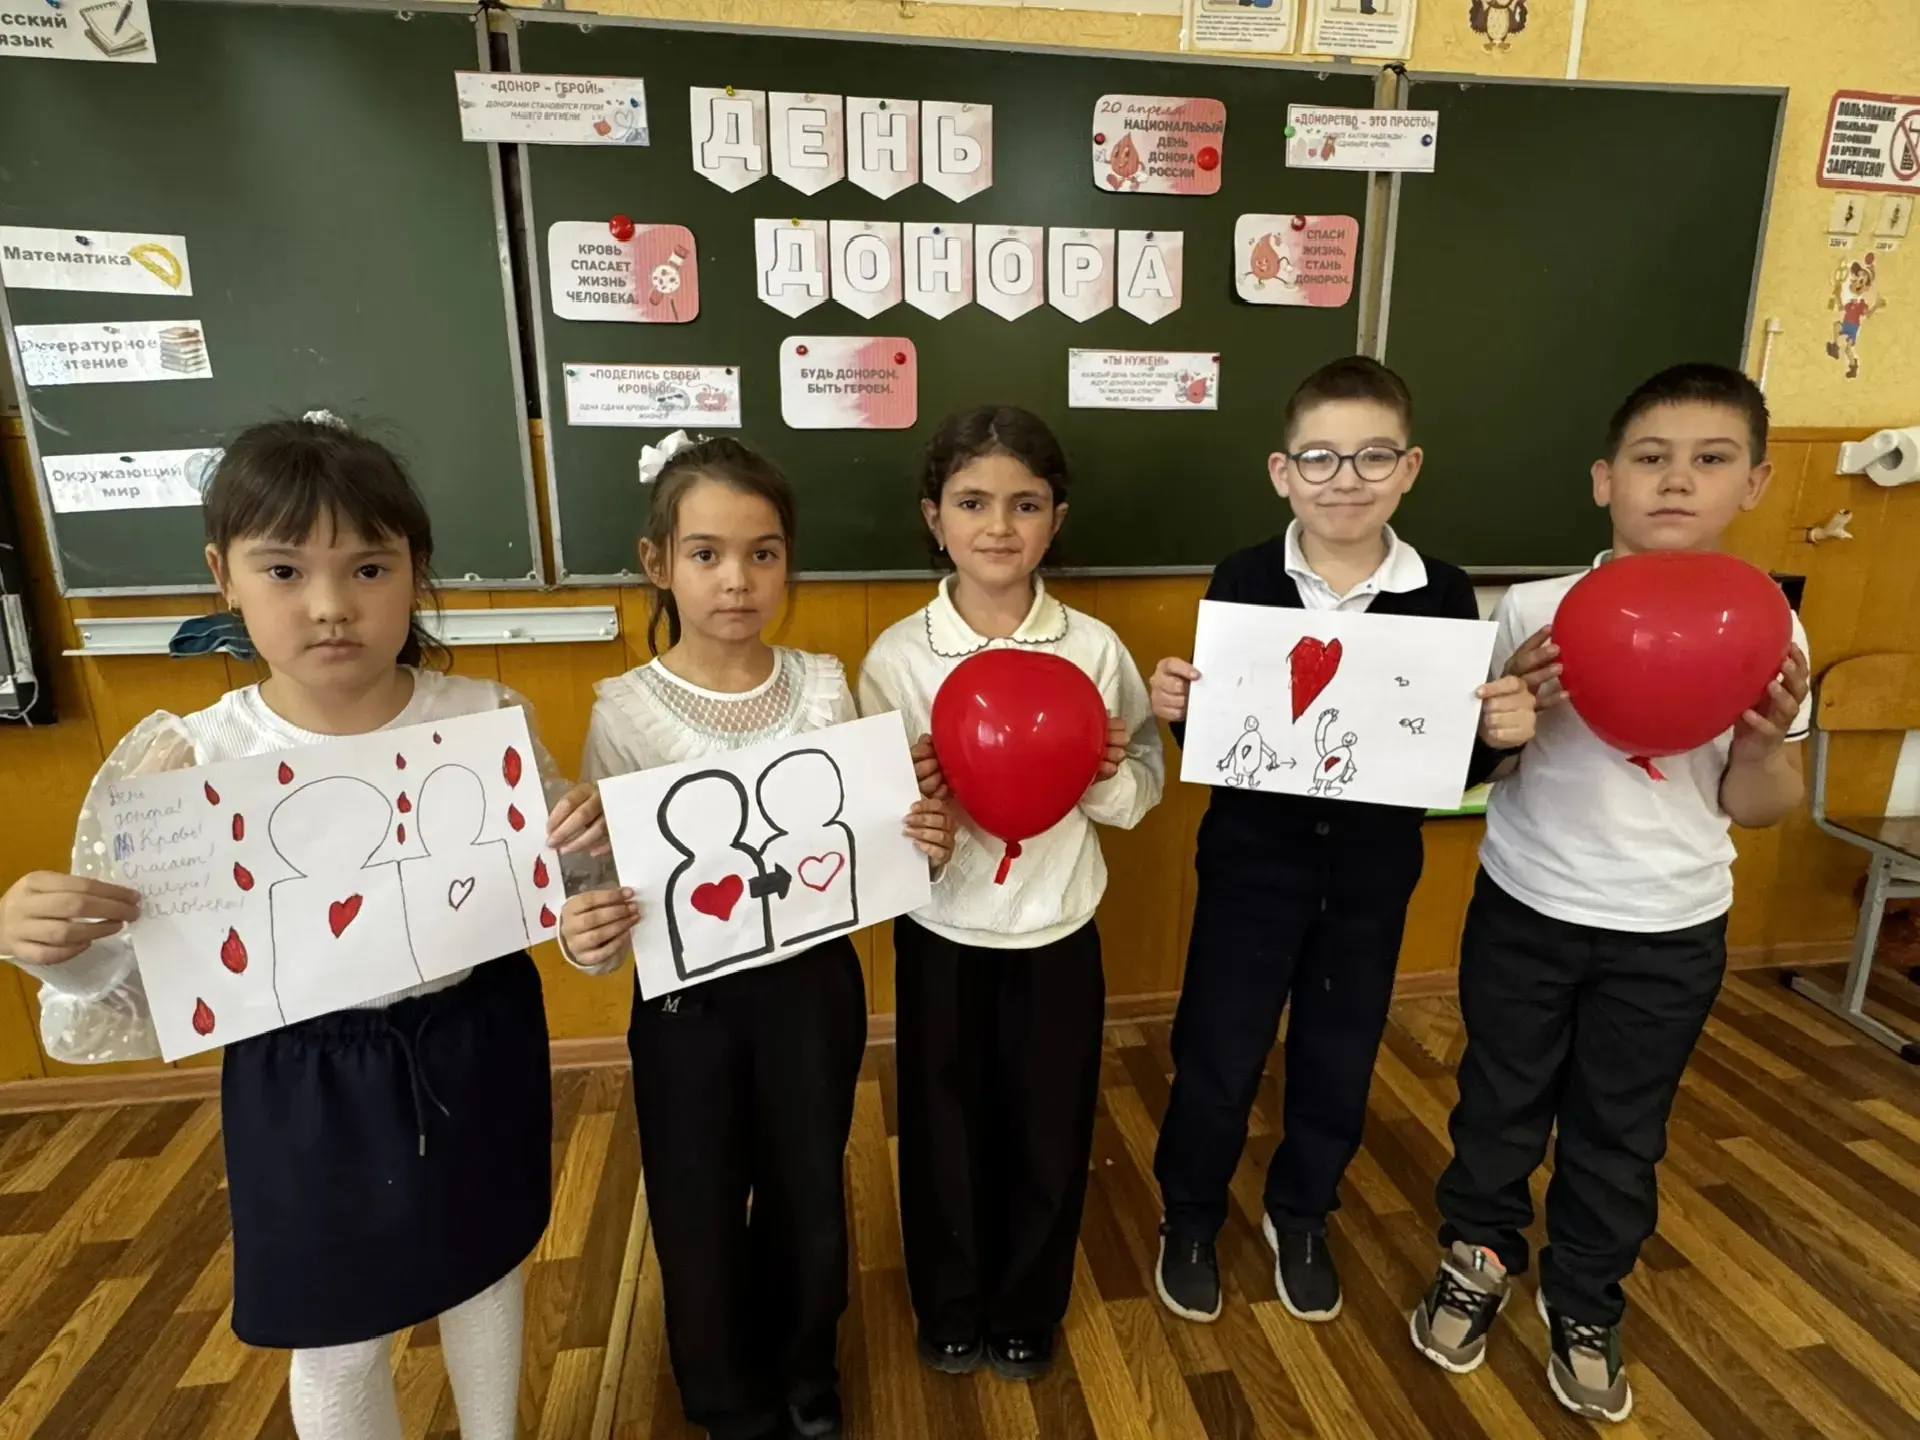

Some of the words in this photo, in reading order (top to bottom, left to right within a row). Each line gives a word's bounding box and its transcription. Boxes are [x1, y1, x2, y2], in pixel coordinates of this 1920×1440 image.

[0, 34, 55, 49] язык
[1101, 100, 1122, 114] 20
[1124, 118, 1223, 133] НАЦИОНАЛЬНЫЙ
[1369, 115, 1387, 127] ЭТО
[701, 97, 982, 173] ДЕНЬ
[1157, 136, 1188, 148] ДЕНЬ
[1148, 151, 1196, 164] ДОНОРА
[1149, 167, 1195, 178] РОССИИ
[1826, 158, 1885, 178] ЗАПРЕЩЕНО!
[1307, 229, 1345, 240] СПАСИ
[3, 245, 132, 266] Математика
[578, 244, 622, 255] КРОВЬ
[571, 260, 631, 272] СПАСАЕТ
[765, 228, 1174, 298] ДОНОРА
[1305, 260, 1341, 270] СТАНЬ
[578, 276, 626, 287] ЖИЗНЬ
[566, 291, 640, 304] ЧЕЛОВЕКА.
[589, 368, 660, 381] «ПОДЕЛИСЬ
[663, 368, 701, 381] СВОЕЙ
[801, 368, 834, 380] БУДЬ
[807, 383, 842, 393] БЫТЬ
[844, 383, 894, 394] ГЕРОЕМ.
[51, 465, 182, 483] Окружающий
[102, 486, 140, 499] мир
